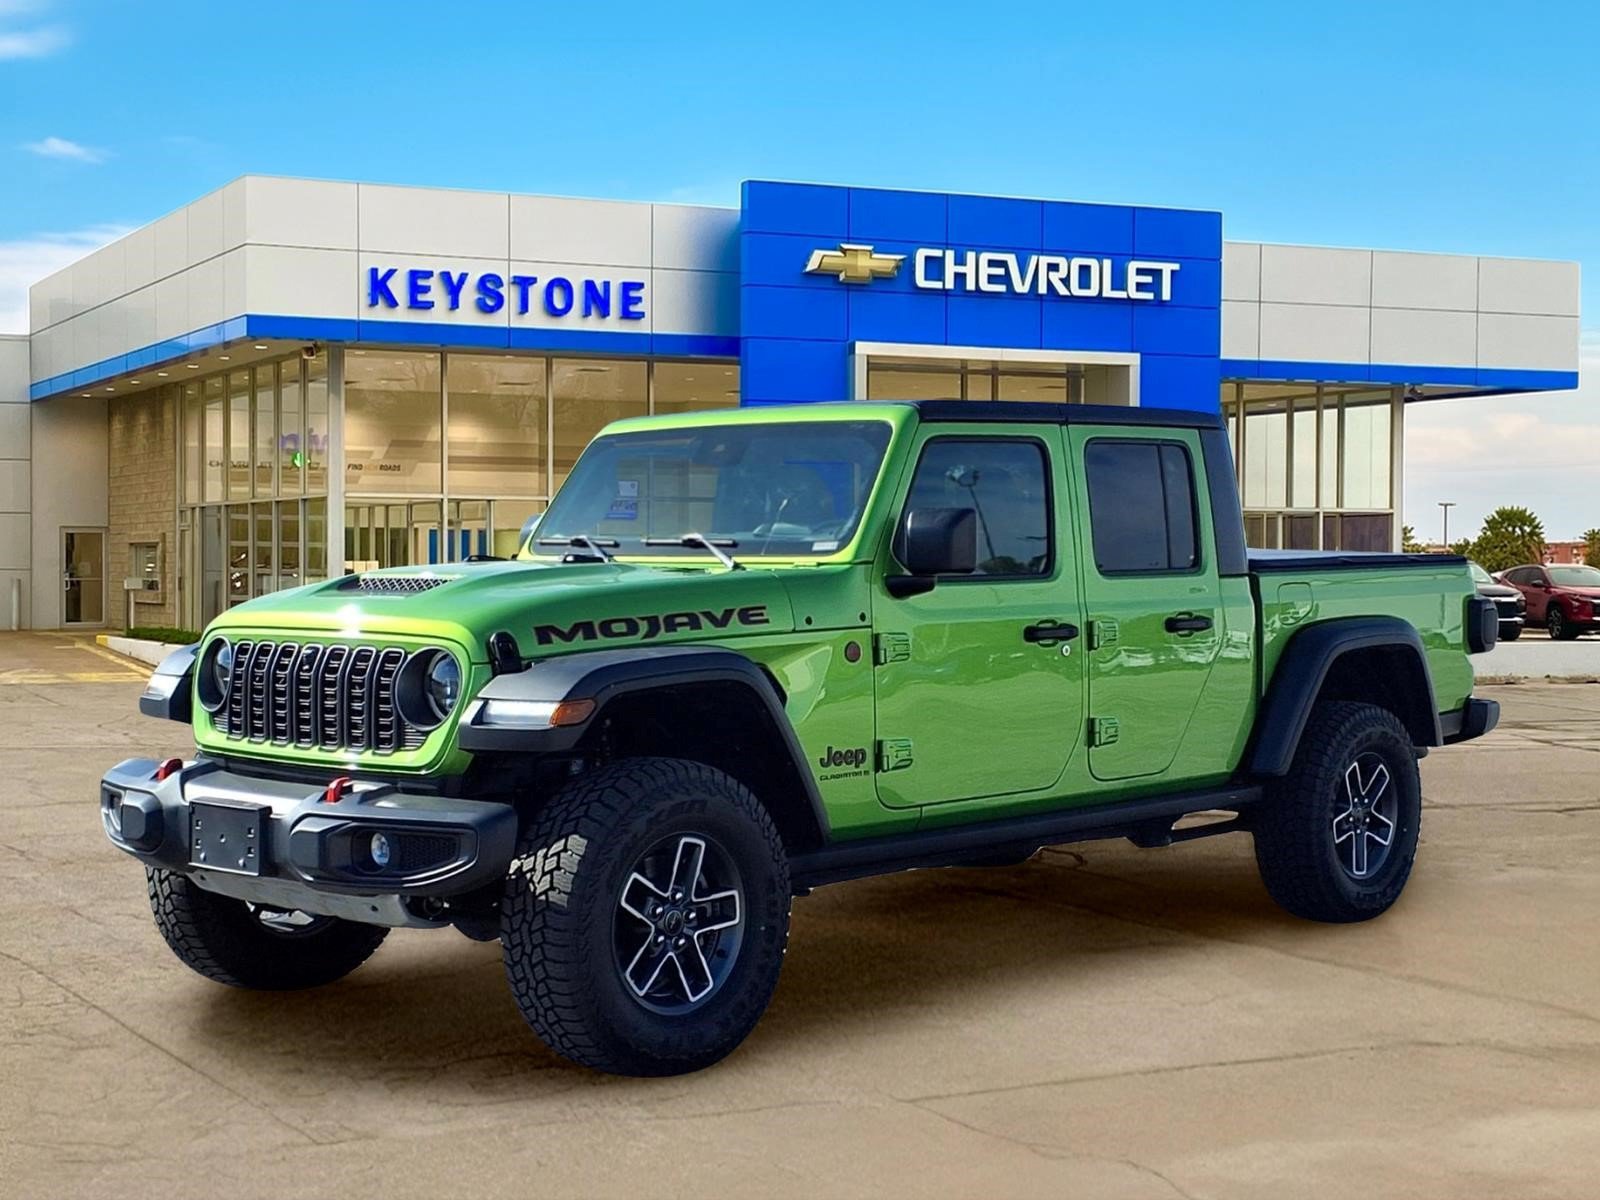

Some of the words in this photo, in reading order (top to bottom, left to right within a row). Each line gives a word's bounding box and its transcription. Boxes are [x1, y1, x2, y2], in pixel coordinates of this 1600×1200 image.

[368, 267, 646, 320] KEYSTONE
[915, 247, 1180, 302] CHEVROLET
[534, 605, 768, 645] MOJAVE
[819, 746, 867, 768] Jeep
